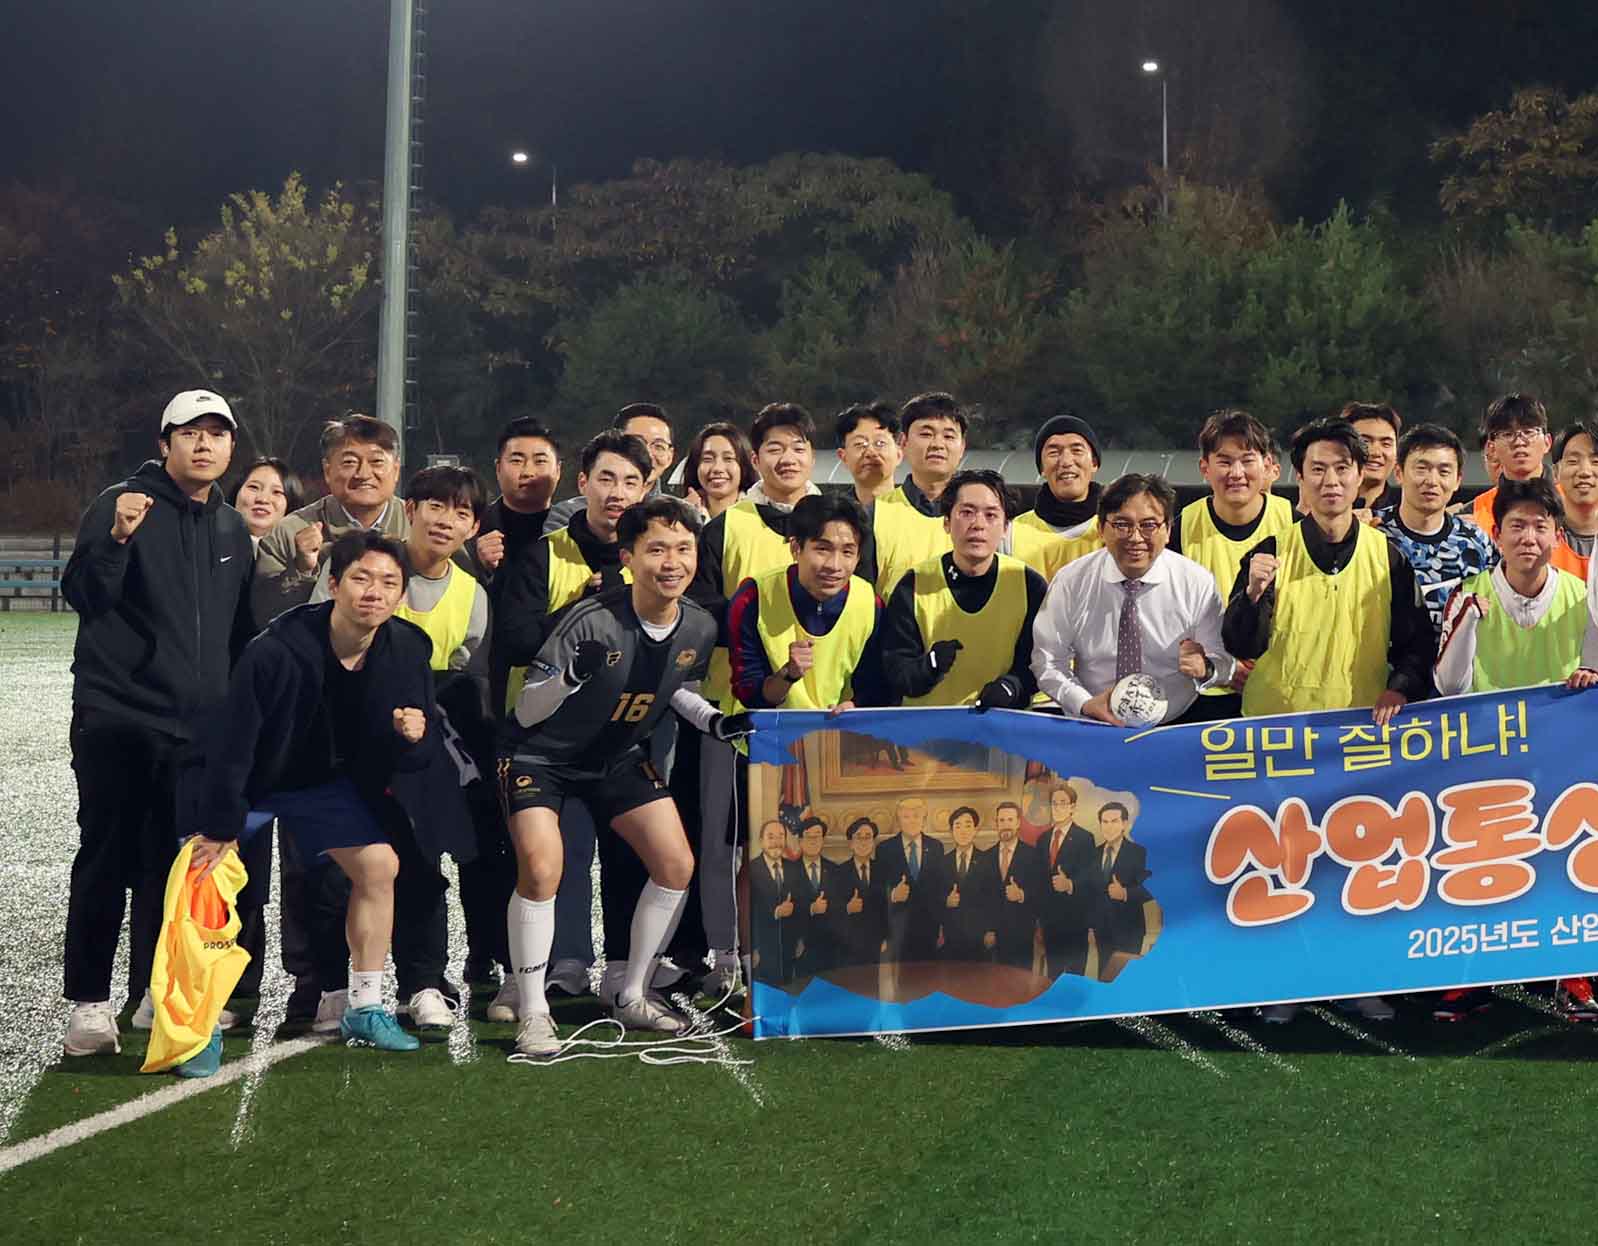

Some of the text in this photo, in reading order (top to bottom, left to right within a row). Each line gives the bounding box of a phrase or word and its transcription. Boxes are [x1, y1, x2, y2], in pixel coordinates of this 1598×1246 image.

[611, 693, 655, 722] 16
[1201, 700, 1530, 781] 일만 잘하냐!
[1408, 919, 1539, 959] 2025년도
